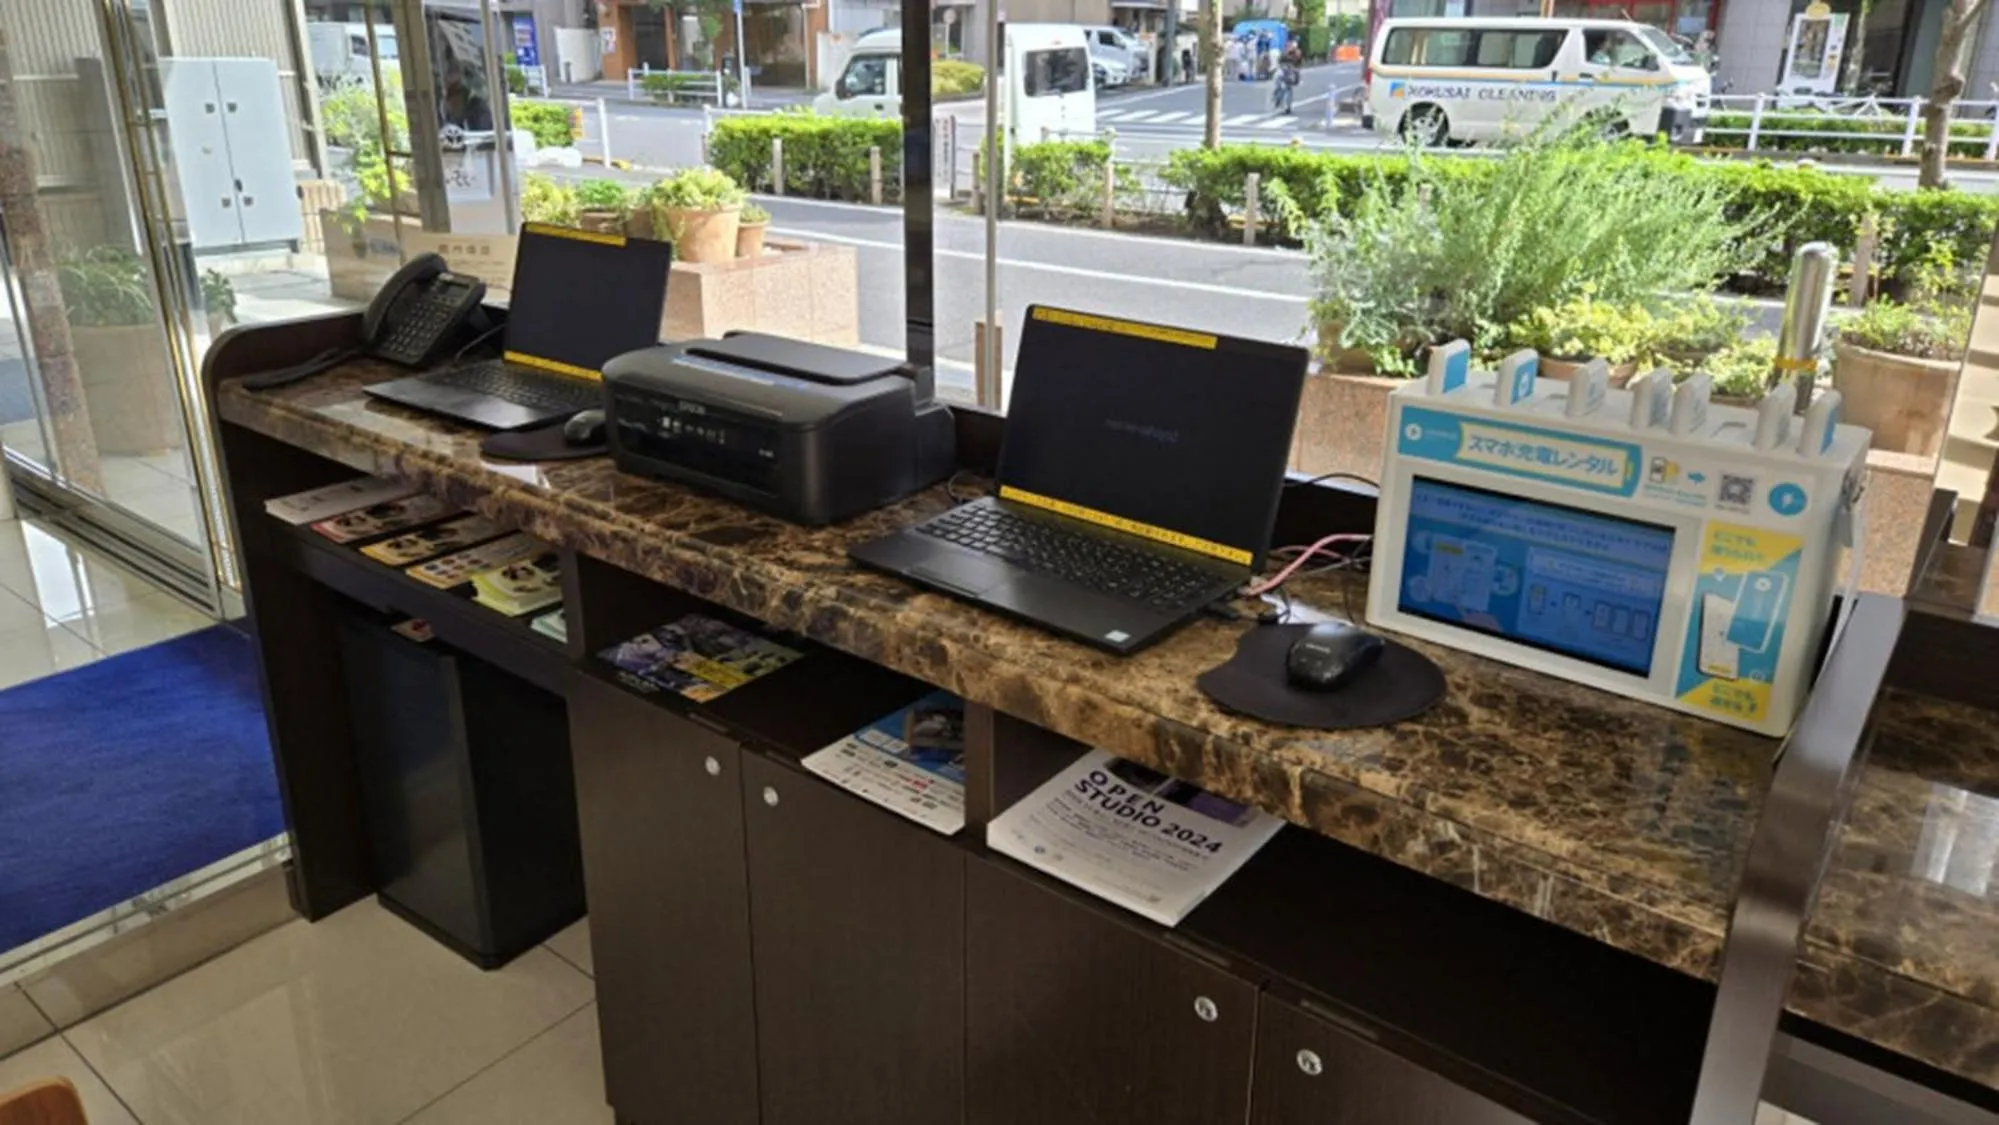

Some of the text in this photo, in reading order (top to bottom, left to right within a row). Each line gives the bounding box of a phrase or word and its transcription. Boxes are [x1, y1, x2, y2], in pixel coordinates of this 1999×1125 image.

[1477, 87, 1556, 101] CLEANING
[1468, 434, 1619, 477] スマホ充電レンタル
[1089, 770, 1165, 813] OPEN
[1074, 779, 1161, 828] STUDIO
[1161, 822, 1223, 853] 2024
